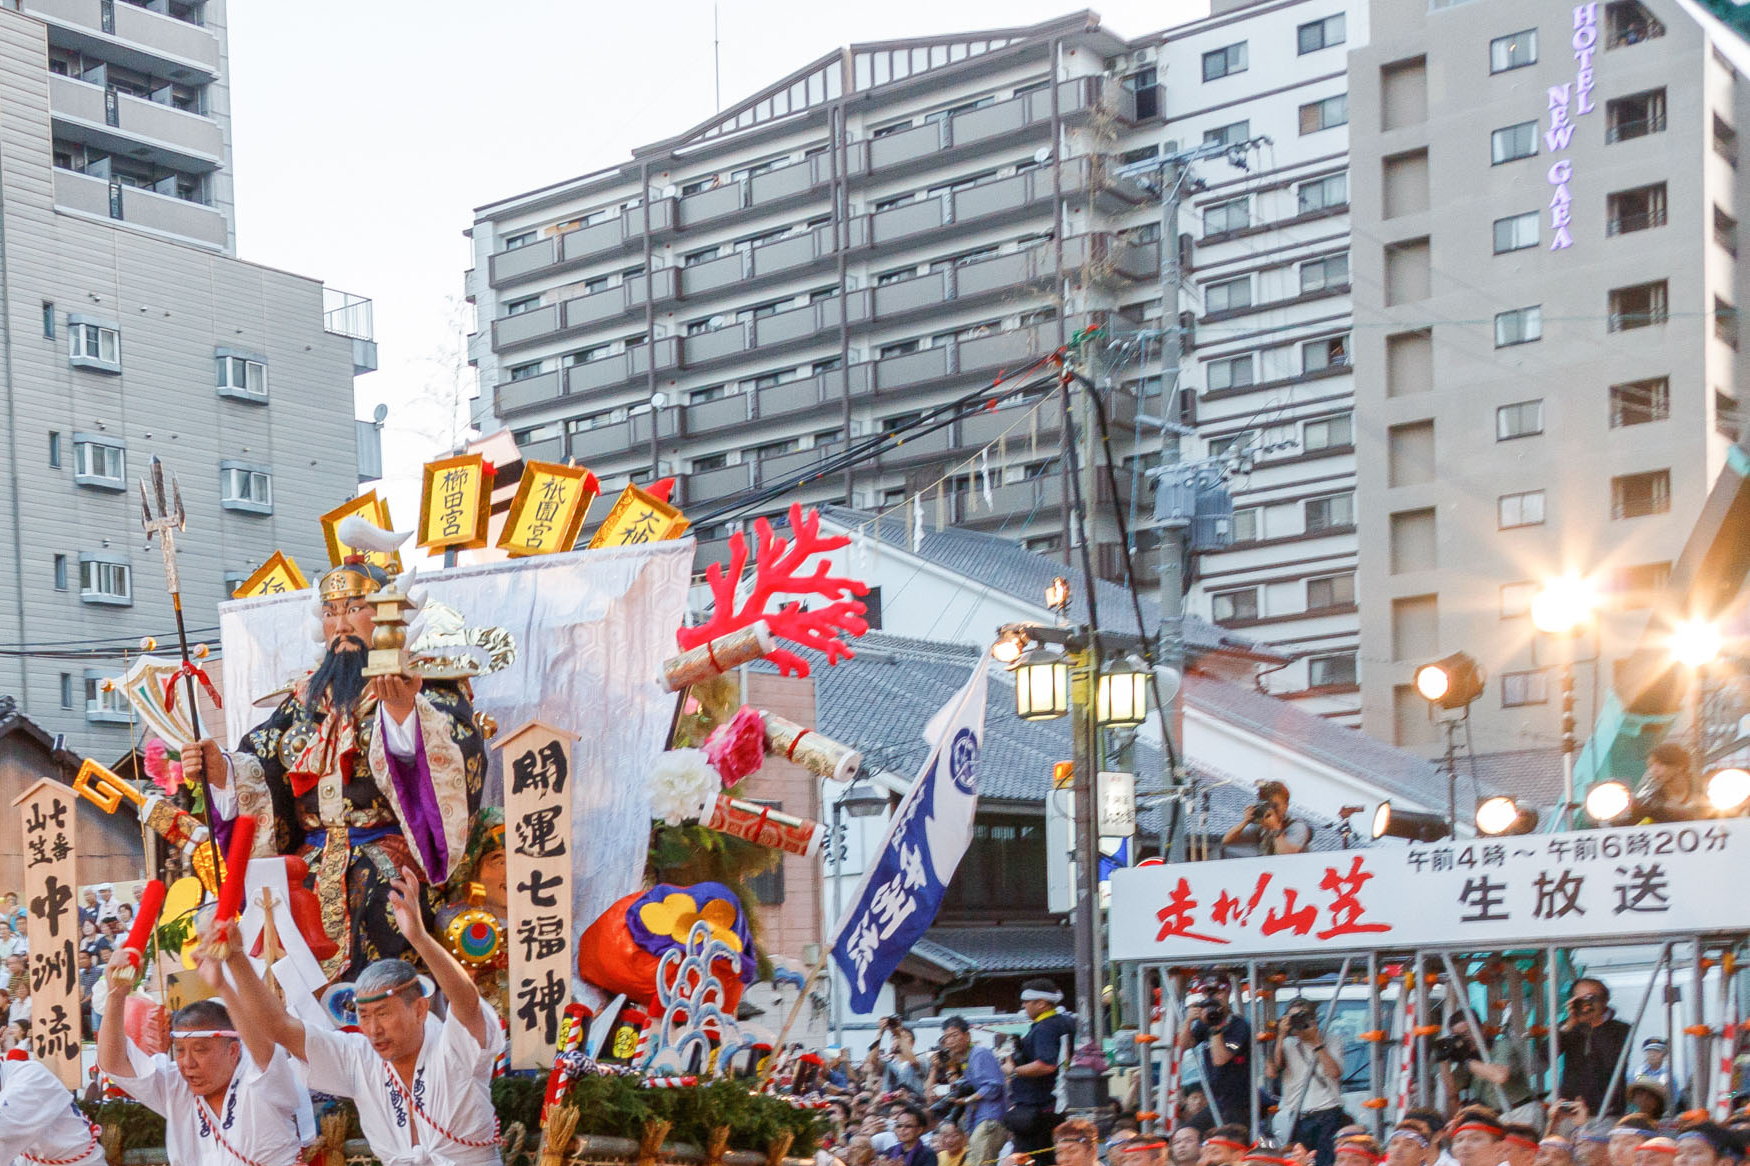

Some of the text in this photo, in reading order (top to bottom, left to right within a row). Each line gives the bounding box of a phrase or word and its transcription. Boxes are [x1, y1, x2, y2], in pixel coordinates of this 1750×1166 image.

[1572, 1, 1597, 115] HOTEL
[1544, 82, 1576, 252] NEW GAEA
[439, 467, 468, 538] 櫛田宮
[25, 802, 53, 868] 山笠
[48, 798, 75, 862] 七番
[512, 740, 568, 1045] 開運七福神
[1457, 862, 1673, 923] 生放送
[31, 875, 79, 1061] 中洲流
